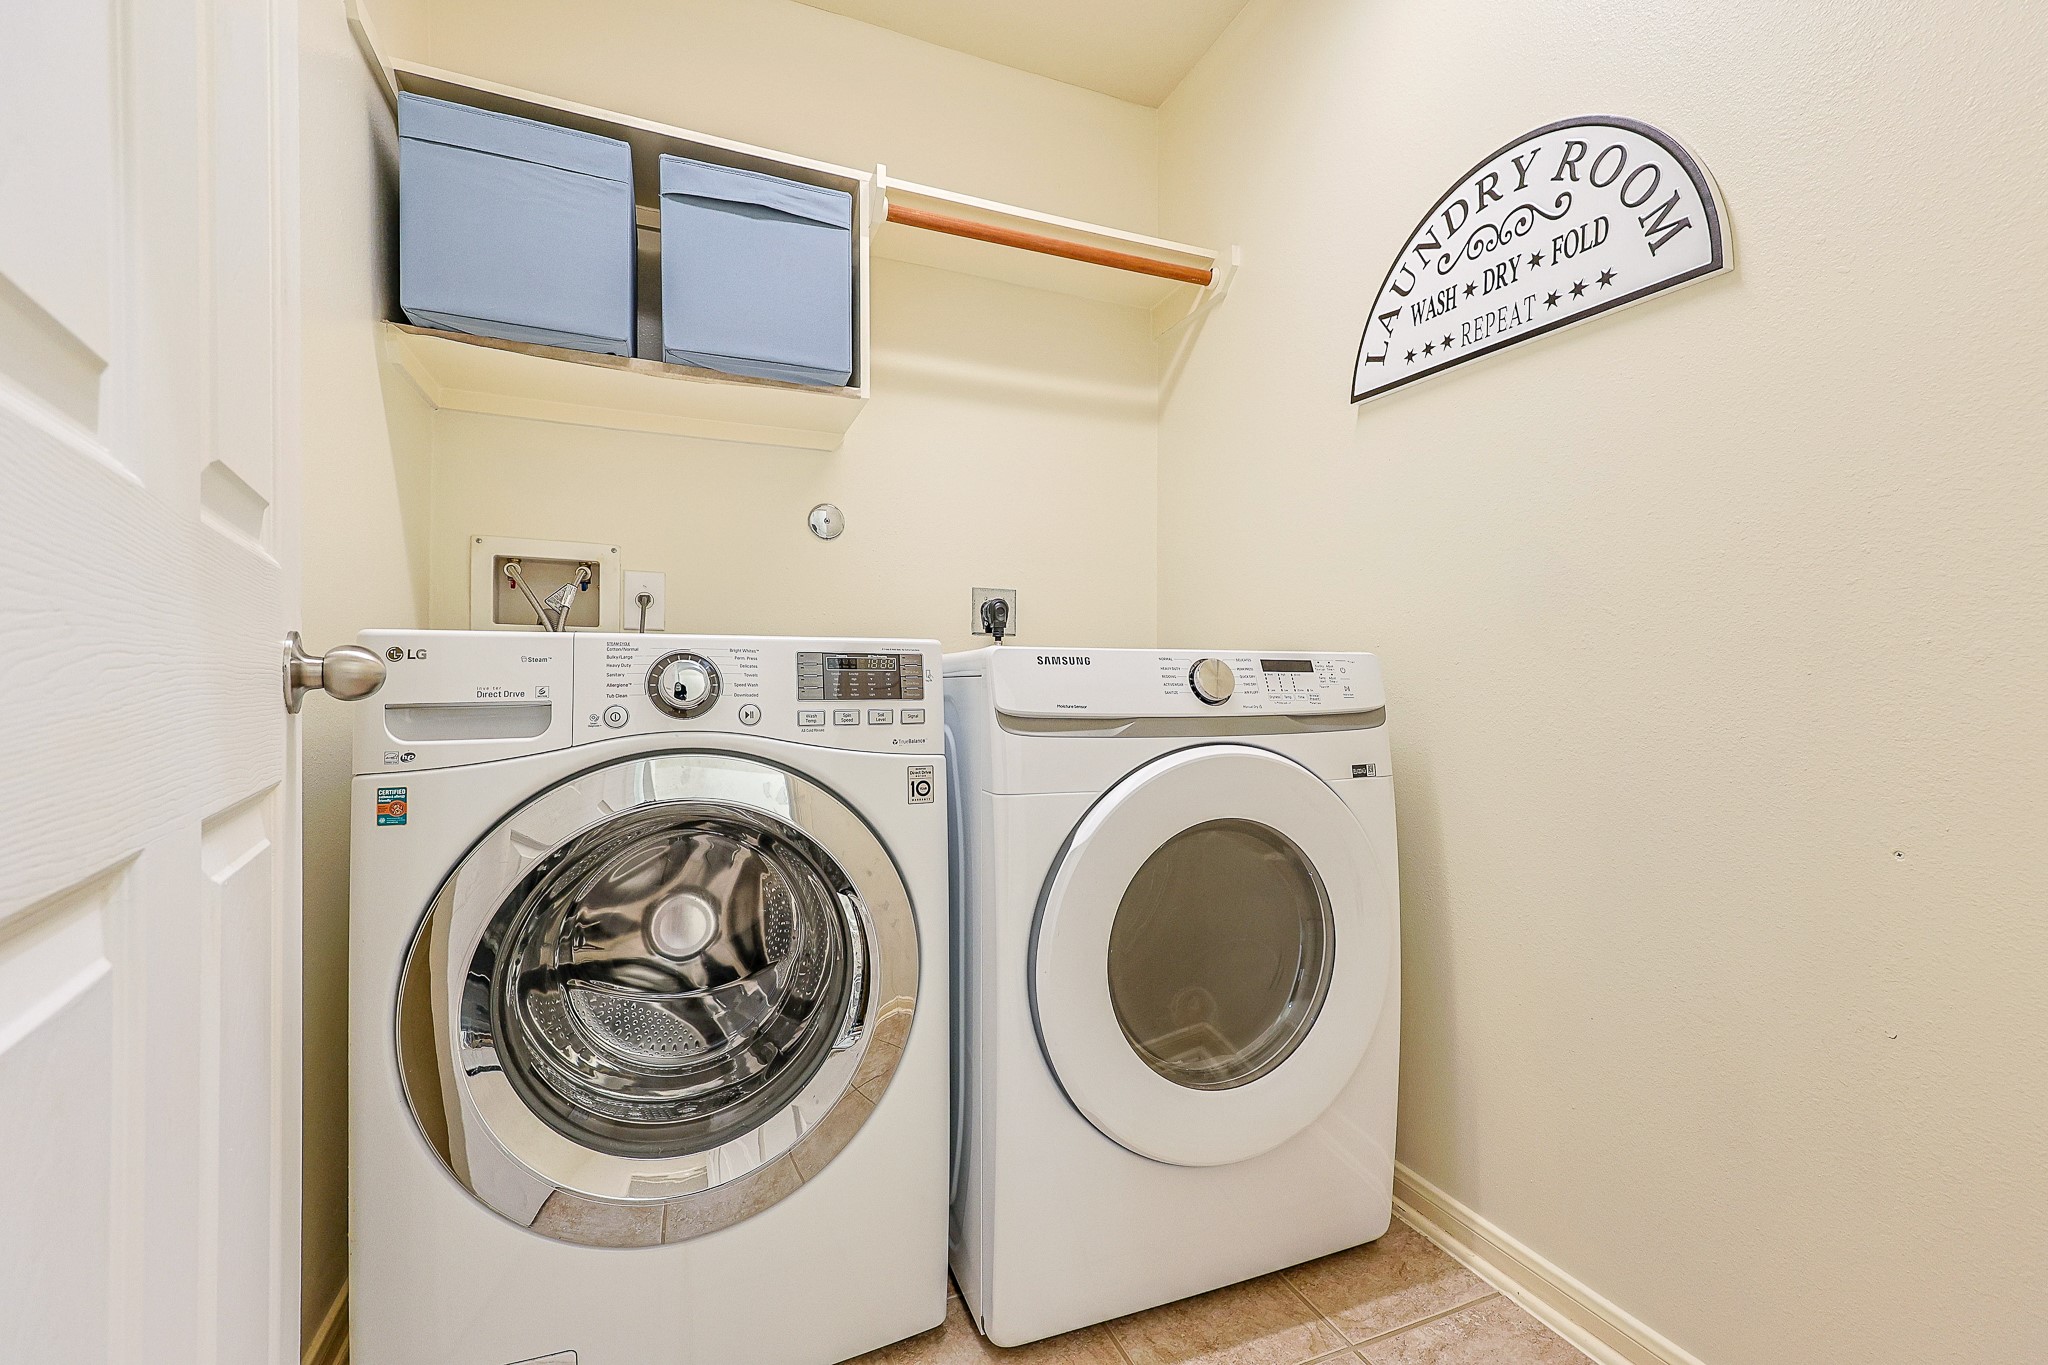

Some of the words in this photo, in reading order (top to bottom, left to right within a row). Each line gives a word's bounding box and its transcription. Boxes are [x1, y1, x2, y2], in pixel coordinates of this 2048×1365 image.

[1365, 147, 1541, 367] LAUNDRY
[1551, 140, 1693, 257] ROOM
[1411, 284, 1458, 327] WASH
[1482, 254, 1522, 296] DRY
[1551, 215, 1610, 267] FOLD
[1460, 294, 1538, 348] REPEAT
[407, 649, 427, 660] LG
[1036, 655, 1091, 666] SAMSUNG
[476, 690, 502, 698] Direct
[378, 788, 406, 796] CERTIFIED
[910, 780, 931, 798] 10
